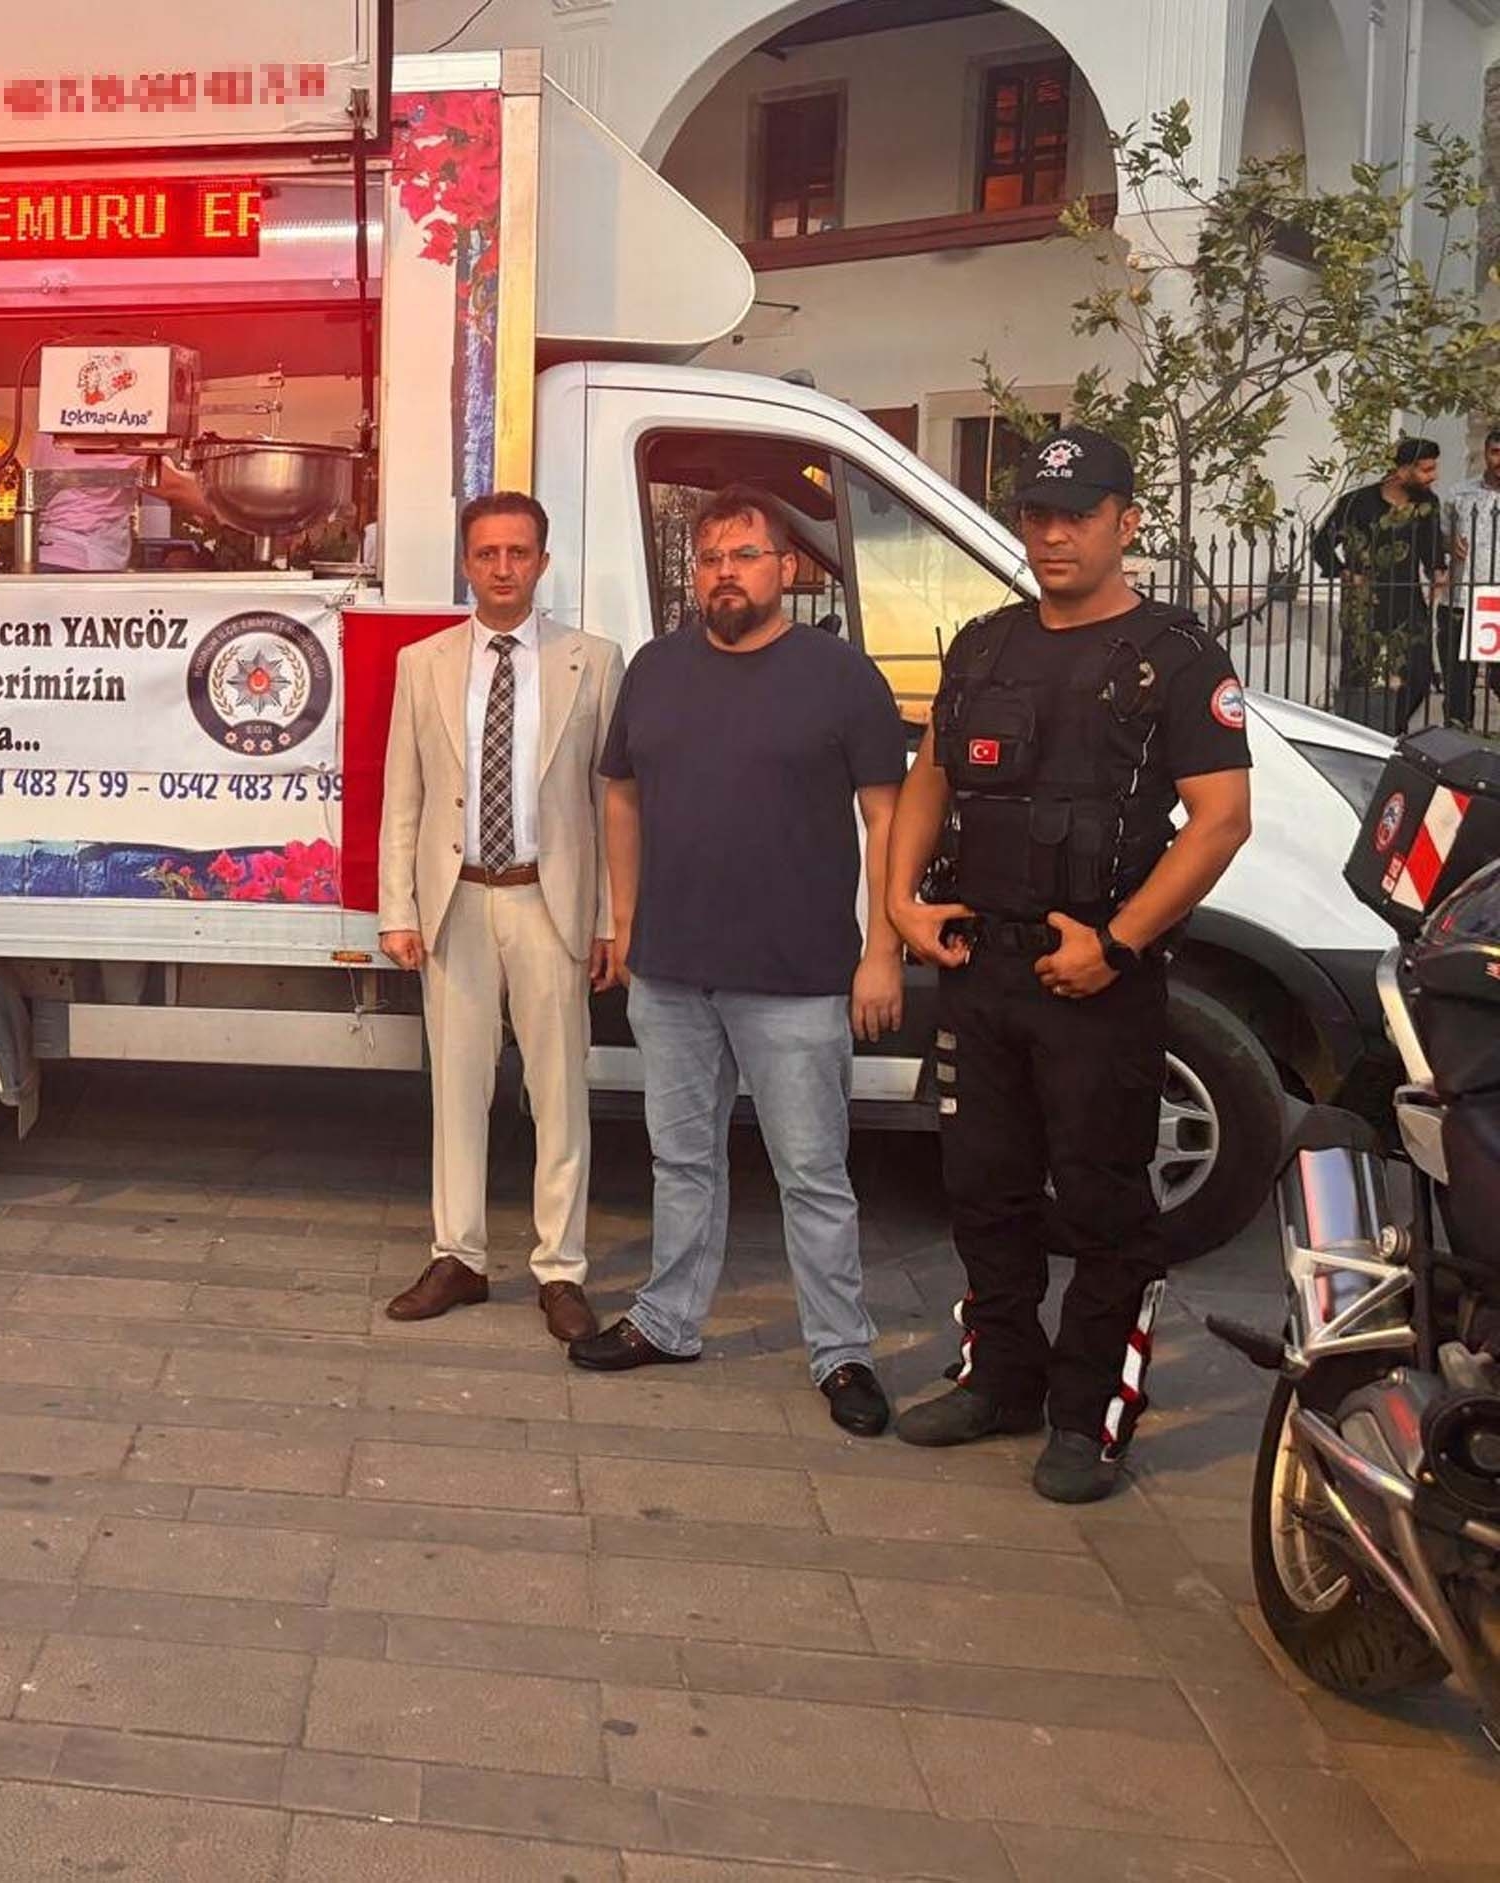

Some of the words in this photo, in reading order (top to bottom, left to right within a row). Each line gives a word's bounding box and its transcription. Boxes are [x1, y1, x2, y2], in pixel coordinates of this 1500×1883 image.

[60, 608, 189, 649] YANGÖZ
[12, 769, 57, 797] 483
[65, 769, 91, 798] 75
[99, 769, 128, 798] 99
[159, 772, 216, 799] 0542
[227, 773, 273, 800] 483
[280, 772, 307, 801] 75
[317, 774, 344, 801] 99
